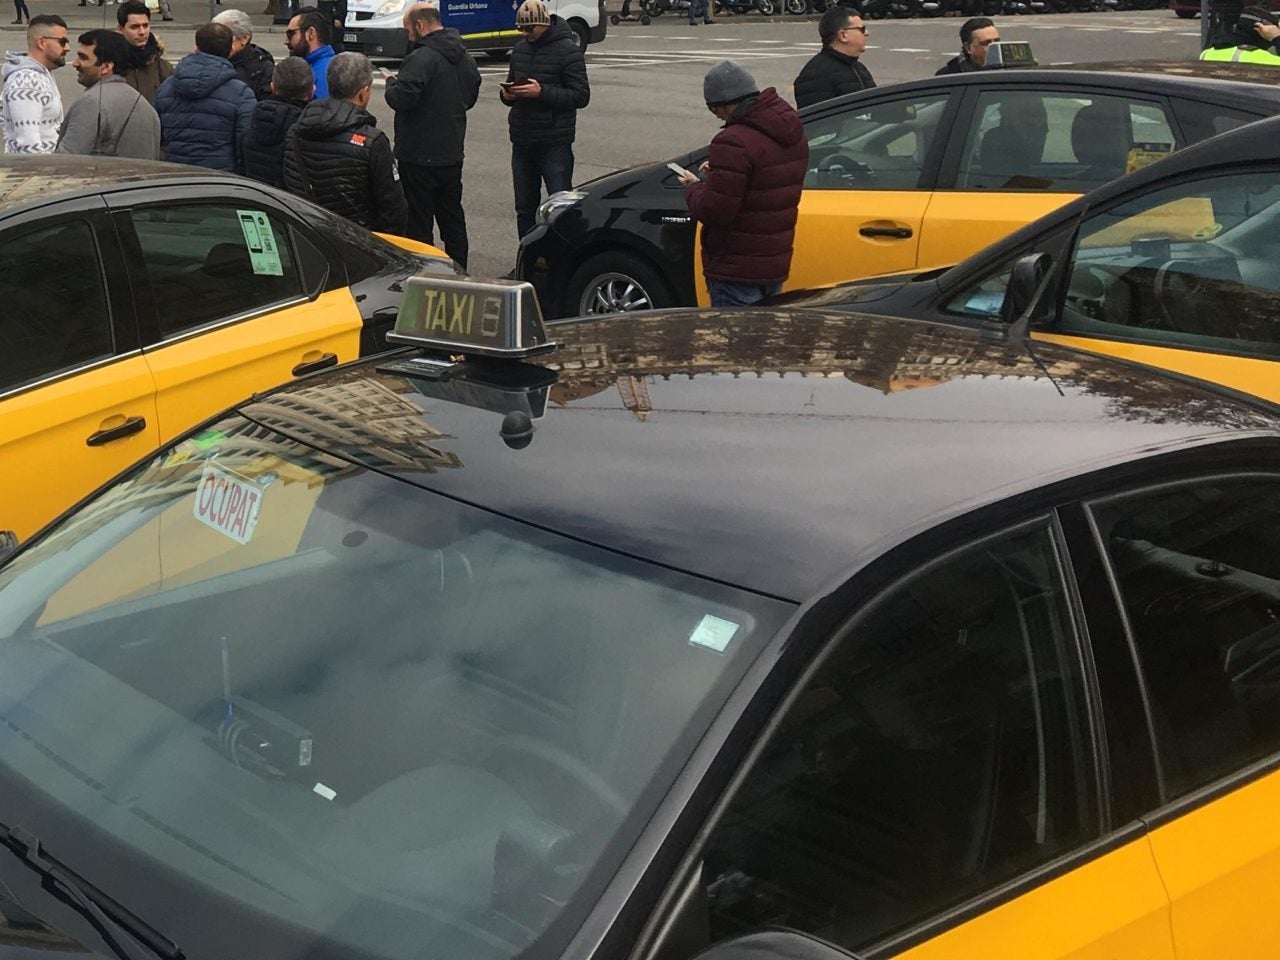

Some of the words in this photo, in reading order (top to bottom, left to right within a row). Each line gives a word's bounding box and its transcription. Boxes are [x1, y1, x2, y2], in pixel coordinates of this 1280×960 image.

[469, 2, 488, 10] Urbana
[424, 289, 475, 335] TAXI
[199, 472, 258, 538] OCUPAT
